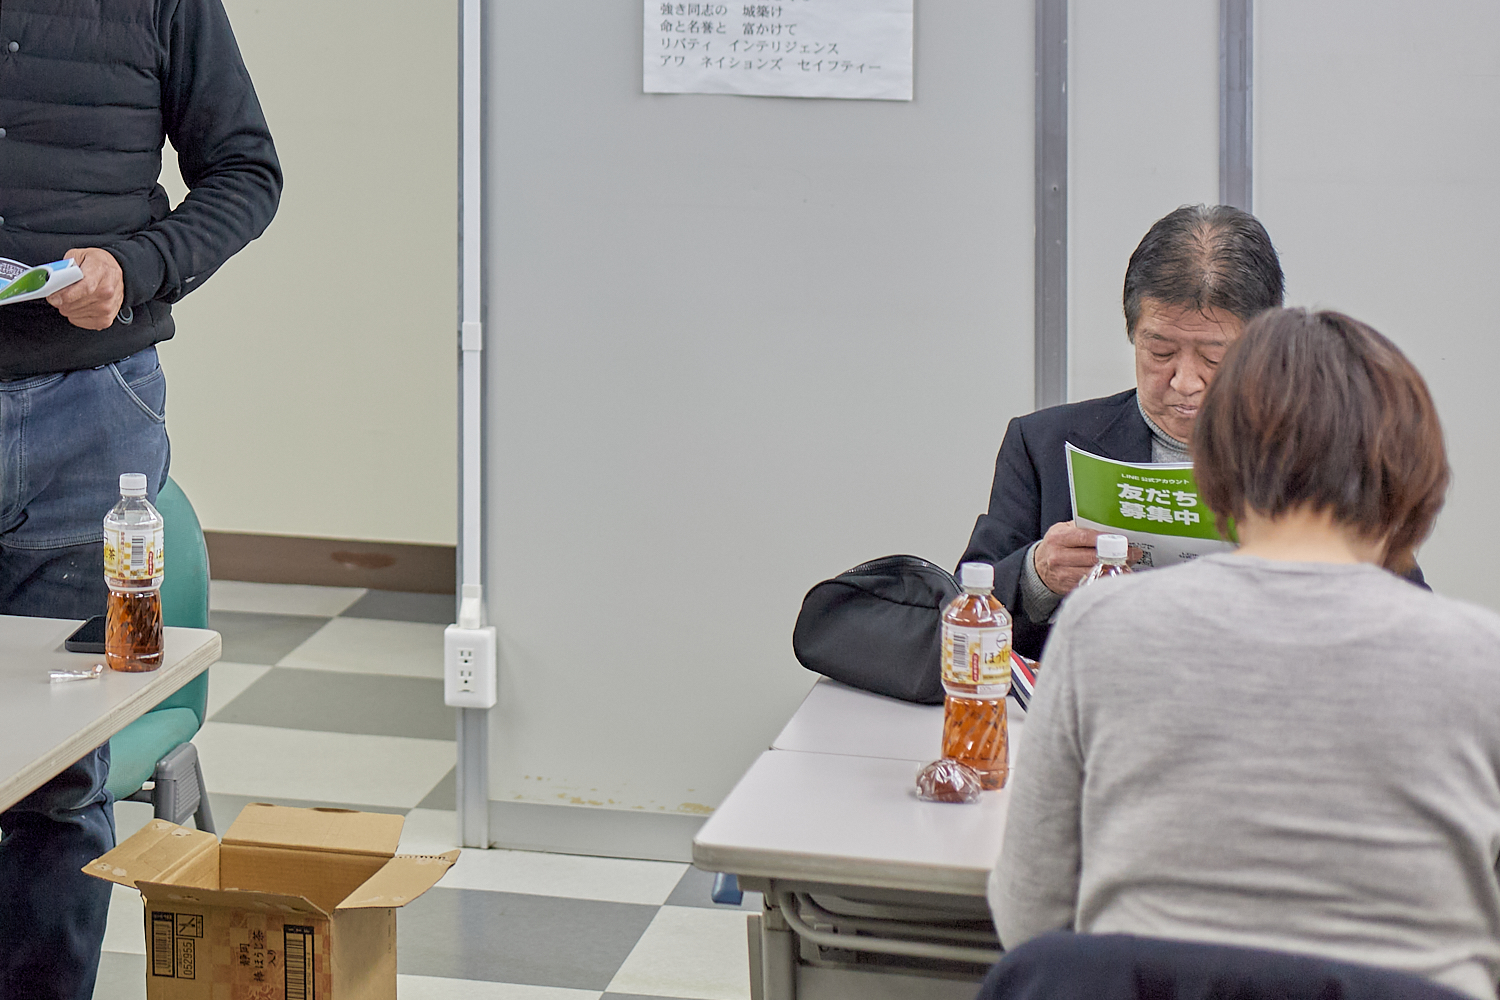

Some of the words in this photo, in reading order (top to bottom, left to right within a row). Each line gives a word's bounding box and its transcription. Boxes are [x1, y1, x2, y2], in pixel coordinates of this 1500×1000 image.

[660, 4, 728, 16] 強き同志の
[660, 20, 727, 34] 命と名誉と
[742, 22, 797, 36] 富かけて
[729, 40, 840, 54] インテリジェンス
[660, 56, 686, 66] アワ
[702, 56, 783, 70] ネイションズ
[798, 58, 882, 73] セイフティー
[1121, 473, 1140, 481] LINE
[1141, 476, 1190, 484] 公式アカウント
[1117, 483, 1198, 507] 友だち
[1119, 501, 1200, 525] 募集中
[183, 942, 193, 976] 052955
